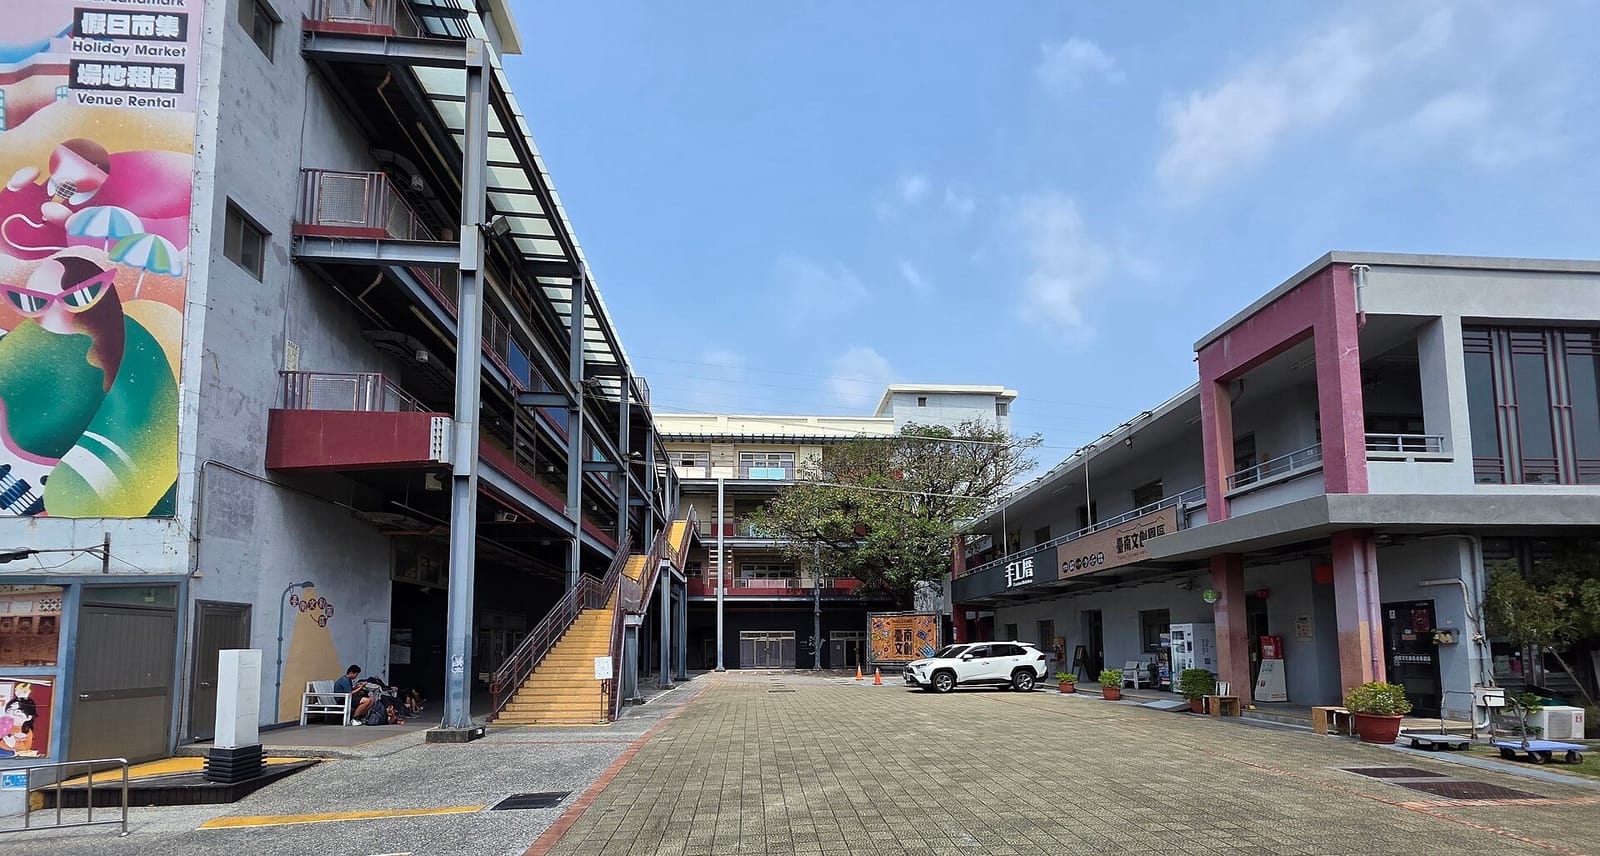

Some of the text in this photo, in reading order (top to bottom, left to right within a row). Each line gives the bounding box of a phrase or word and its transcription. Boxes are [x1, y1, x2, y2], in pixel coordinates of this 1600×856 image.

[81, 12, 179, 37] 假日市集
[72, 41, 187, 57] Holiday Market
[77, 63, 177, 89] 場地租借
[78, 93, 176, 108] Venue Rental
